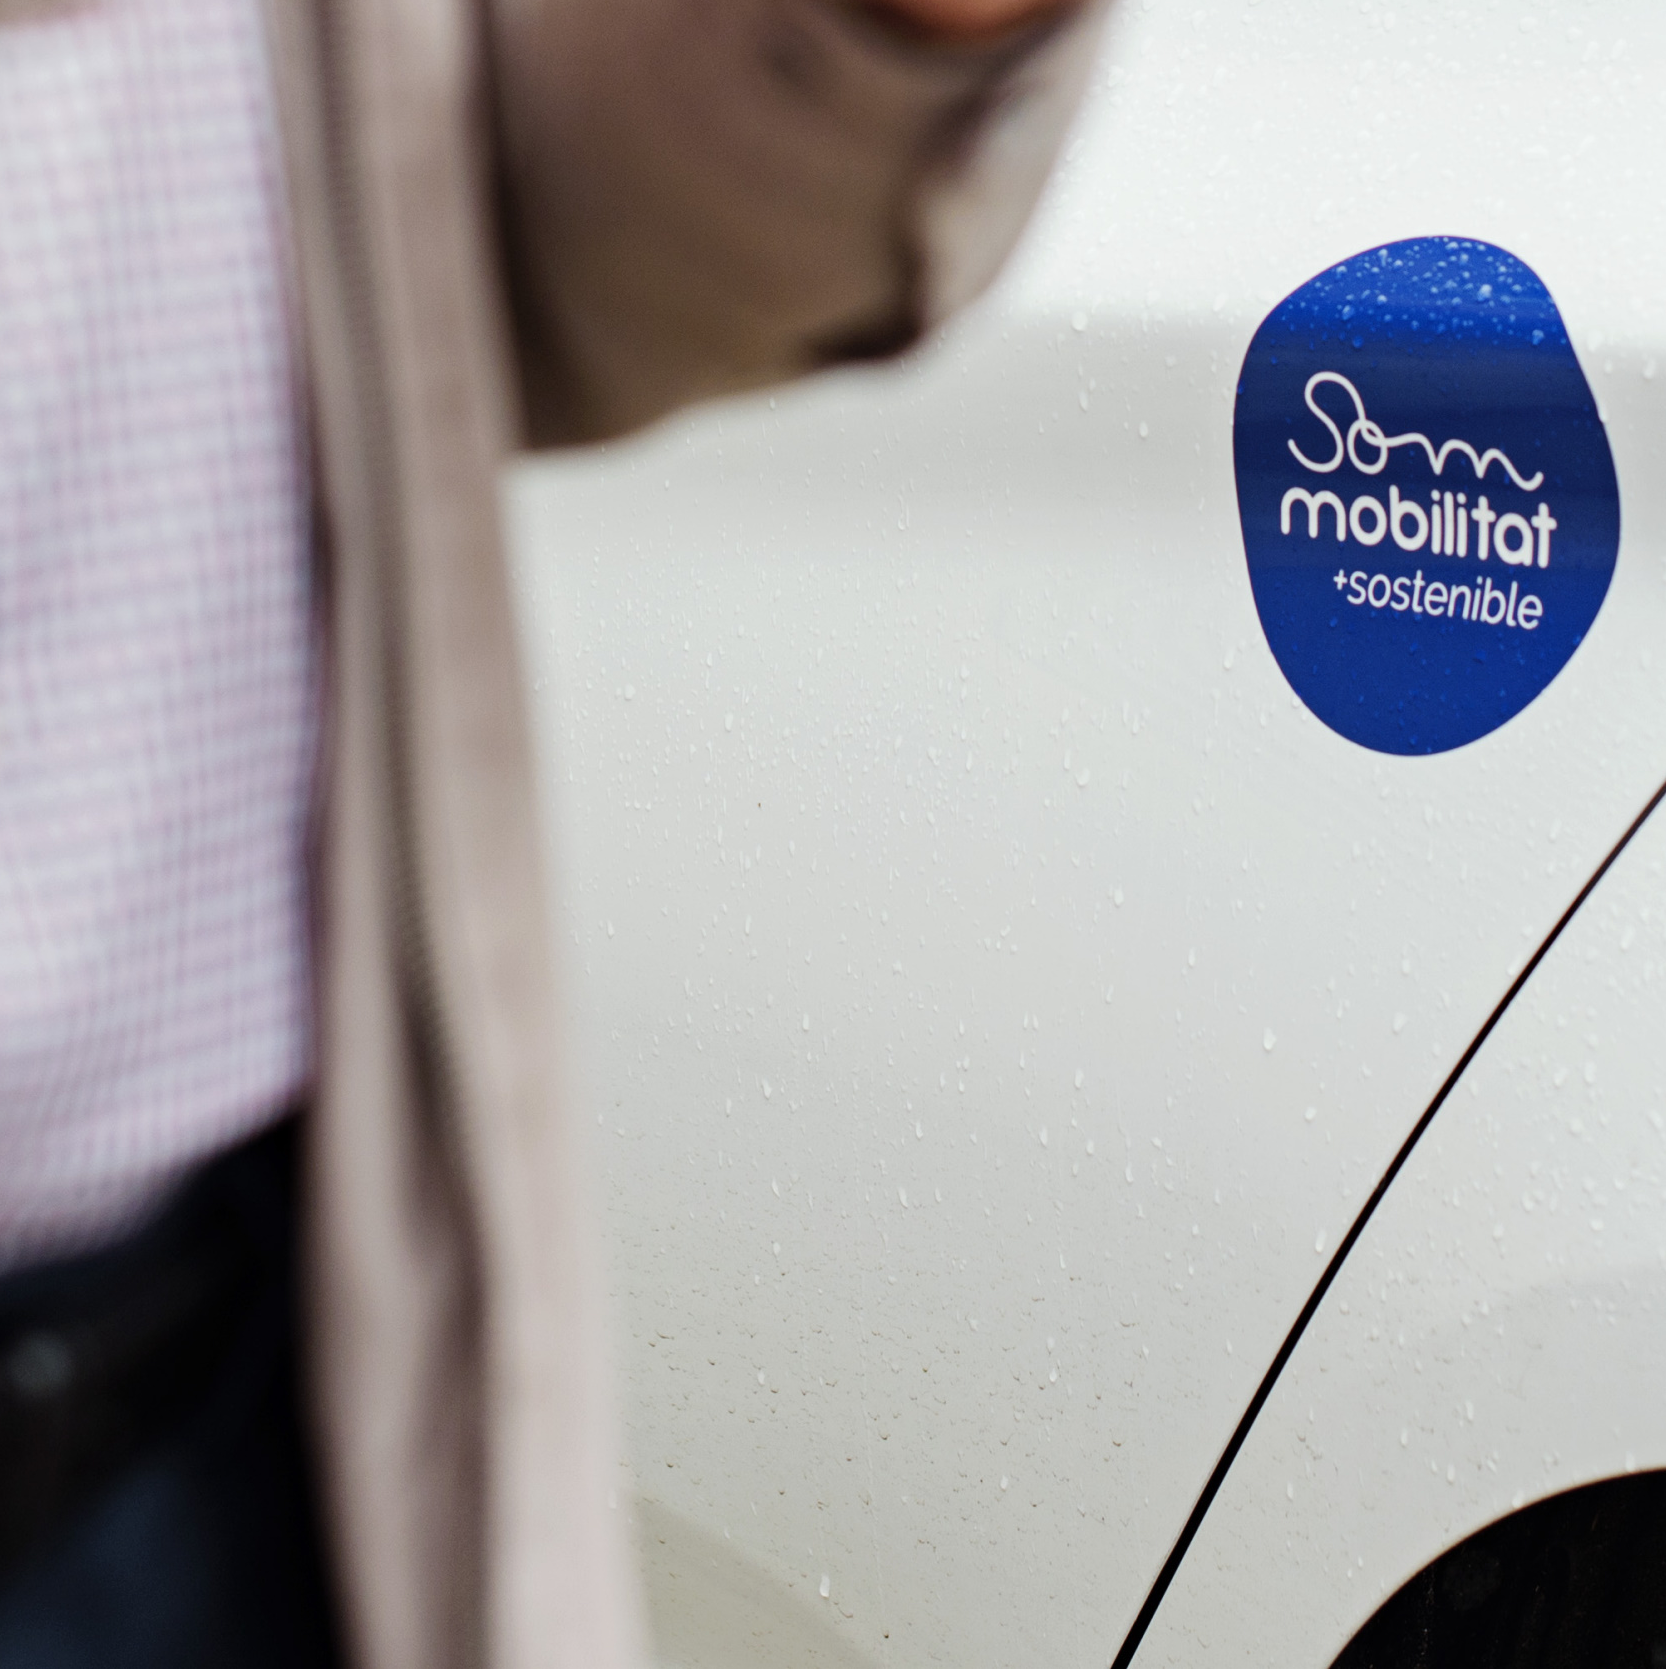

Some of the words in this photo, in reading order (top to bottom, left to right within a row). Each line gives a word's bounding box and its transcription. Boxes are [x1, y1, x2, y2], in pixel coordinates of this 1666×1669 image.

[1287, 371, 1544, 492] Som
[1280, 484, 1558, 569] mobilitat
[1333, 569, 1543, 630] +sostenible
